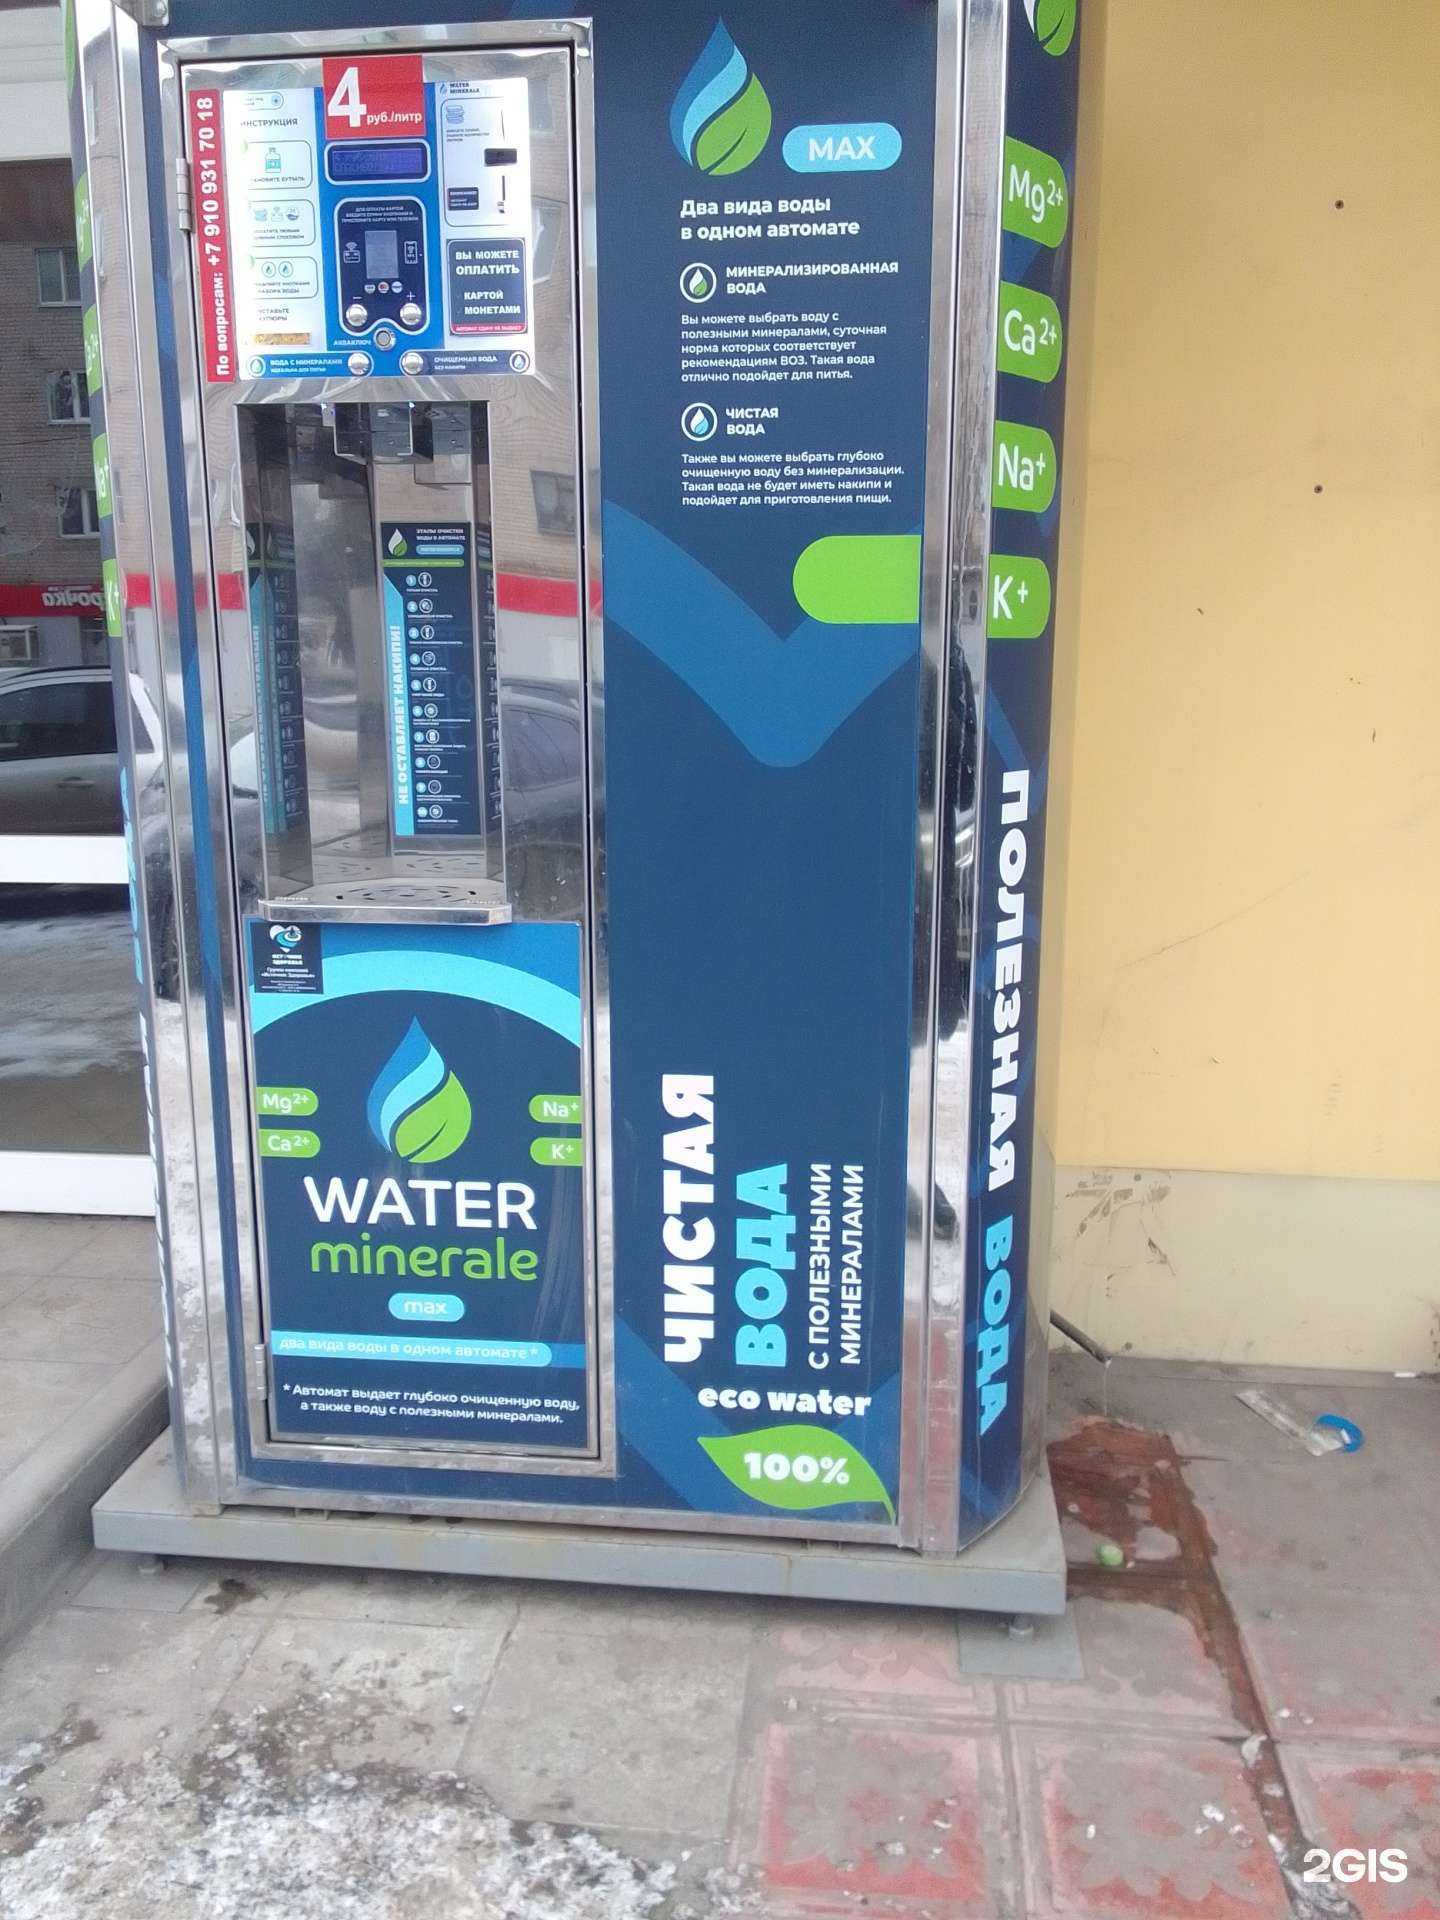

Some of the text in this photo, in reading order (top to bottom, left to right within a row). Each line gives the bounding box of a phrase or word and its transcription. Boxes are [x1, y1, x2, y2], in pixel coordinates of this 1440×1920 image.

[328, 67, 422, 127] 4 руб./литр
[808, 135, 877, 161] MAX
[680, 199, 831, 218] Два вида воды
[197, 97, 230, 376] По вопросам: +7 910 931 70 18
[680, 222, 860, 241] в одном автомате
[455, 250, 520, 260] ВЫ МОЖЕТЕ
[455, 264, 520, 275] ОПЛАТИТЬ
[726, 262, 899, 278] МИНЕРАЛИЗИРОВАННАЯ
[464, 289, 504, 300] КАРТОЙ
[726, 283, 766, 295] ВОДА
[464, 305, 520, 315] МОНЕТАМИ
[681, 313, 839, 325] Вы можете выбрать воду с
[681, 325, 887, 339] полезными минералами, суточная
[681, 341, 857, 355] норма которых соответствует
[681, 355, 875, 370] рекомендациям ВОЗ. Такая вода
[681, 369, 853, 382] отлично подойдет для питья.
[725, 408, 779, 418] ЧИСТАЯ
[726, 424, 765, 436] ВОДА
[681, 451, 884, 463] Также вы можете выбрать глубоко
[681, 465, 905, 479] очищенную воду без минерализации.
[681, 479, 892, 492] Такая вода не будет иметь накипи и
[681, 493, 892, 507] подойдет для приготовления пищи.
[390, 625, 409, 804] НЕ ОСТАВЛЯЕТ НАКИПИ!
[977, 770, 1029, 1435] ПОЛЕЗНАЯ ВОДА
[303, 1176, 538, 1230] WATER
[662, 1074, 715, 1363] ЧИСТАЯ
[310, 1232, 538, 1281] minerale
[735, 1163, 796, 1367] ВОДА
[840, 1165, 864, 1365] МИНЕРАЛАМИ
[808, 1163, 832, 1370] С ПОЛЕЗНЫМИ
[404, 1299, 447, 1315] max
[279, 1339, 528, 1359] два вида воды в одном автомате
[292, 1386, 580, 1411] Автомат выдает глубоко очищенную воду,
[698, 1387, 872, 1416] eco water
[300, 1402, 563, 1424] а также воду с полезными минералами.
[743, 1452, 850, 1485] 100%
